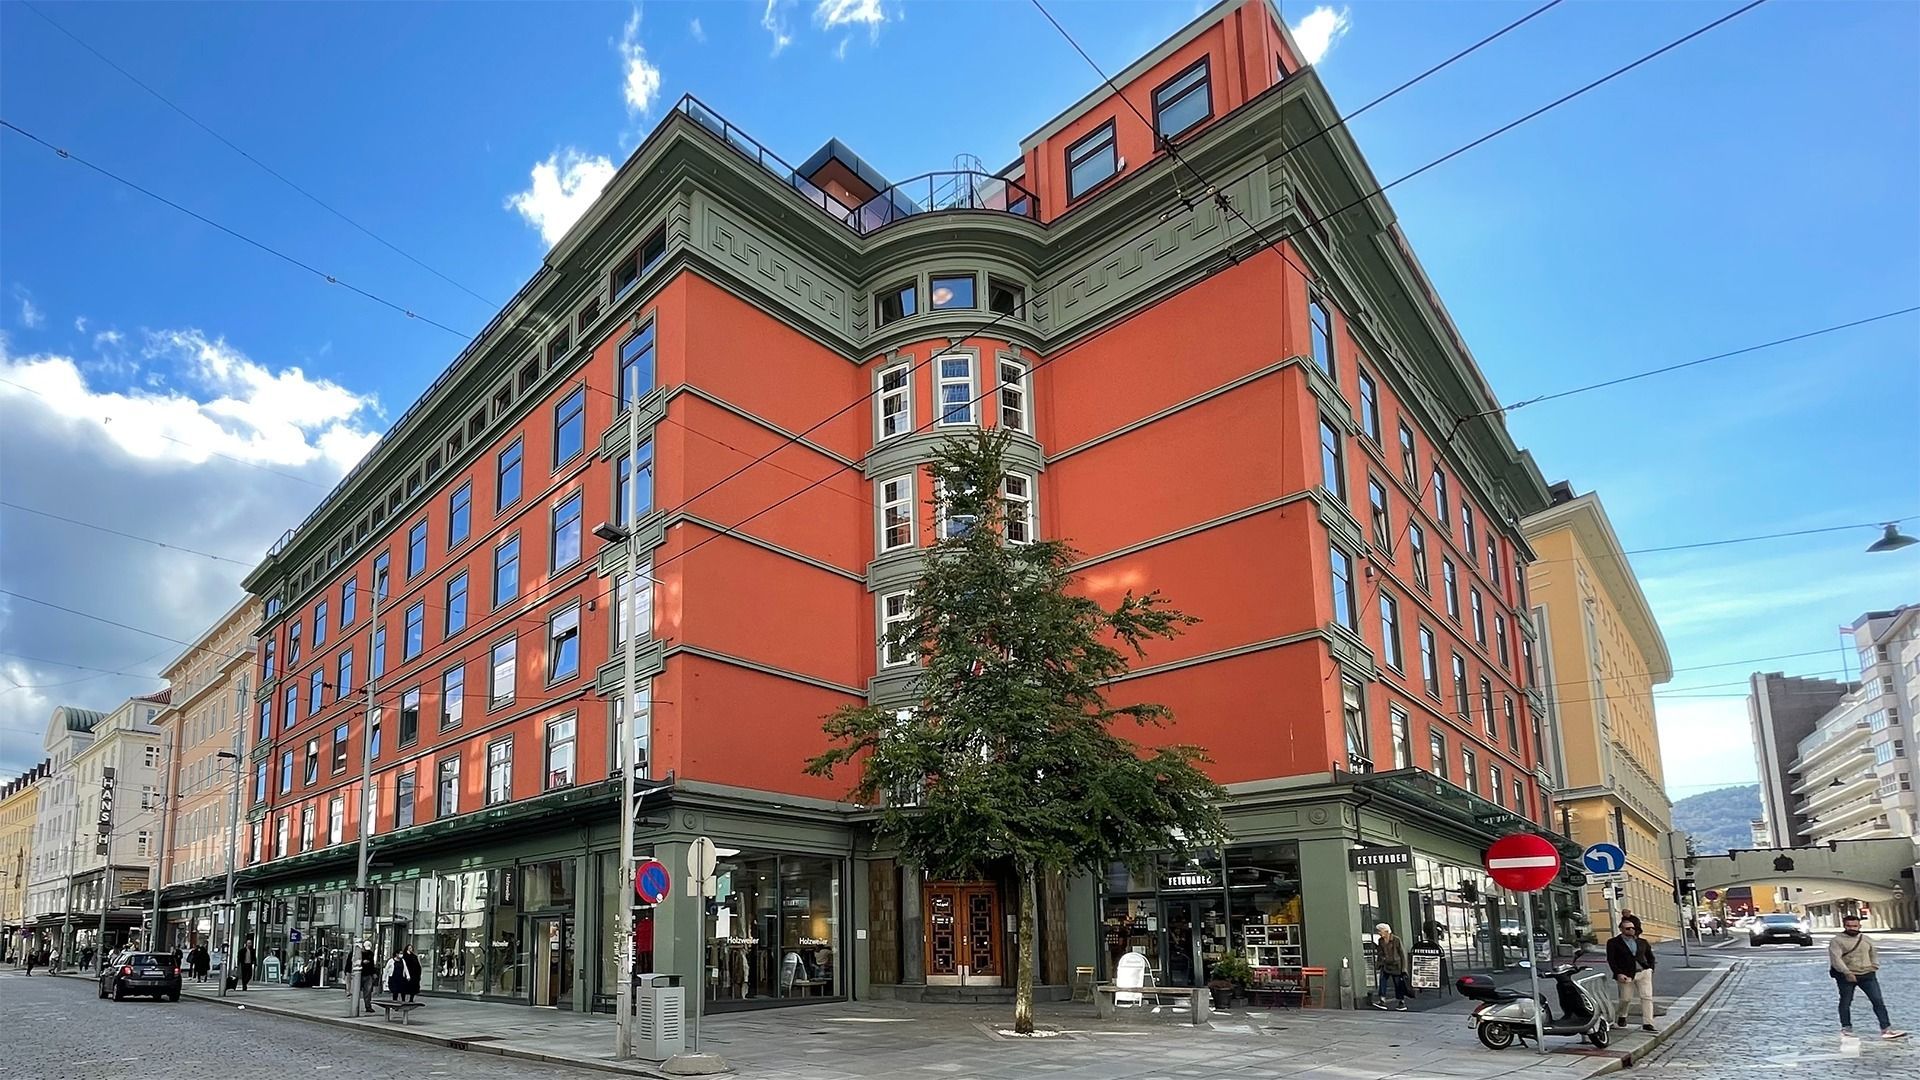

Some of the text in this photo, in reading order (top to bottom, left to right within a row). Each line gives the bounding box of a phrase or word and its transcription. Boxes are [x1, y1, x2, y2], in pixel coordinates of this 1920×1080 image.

[101, 778, 114, 821] HANS
[1357, 853, 1408, 865] FETEVARER
[727, 936, 759, 945] Holzweiler
[799, 937, 828, 945] Holzweiler
